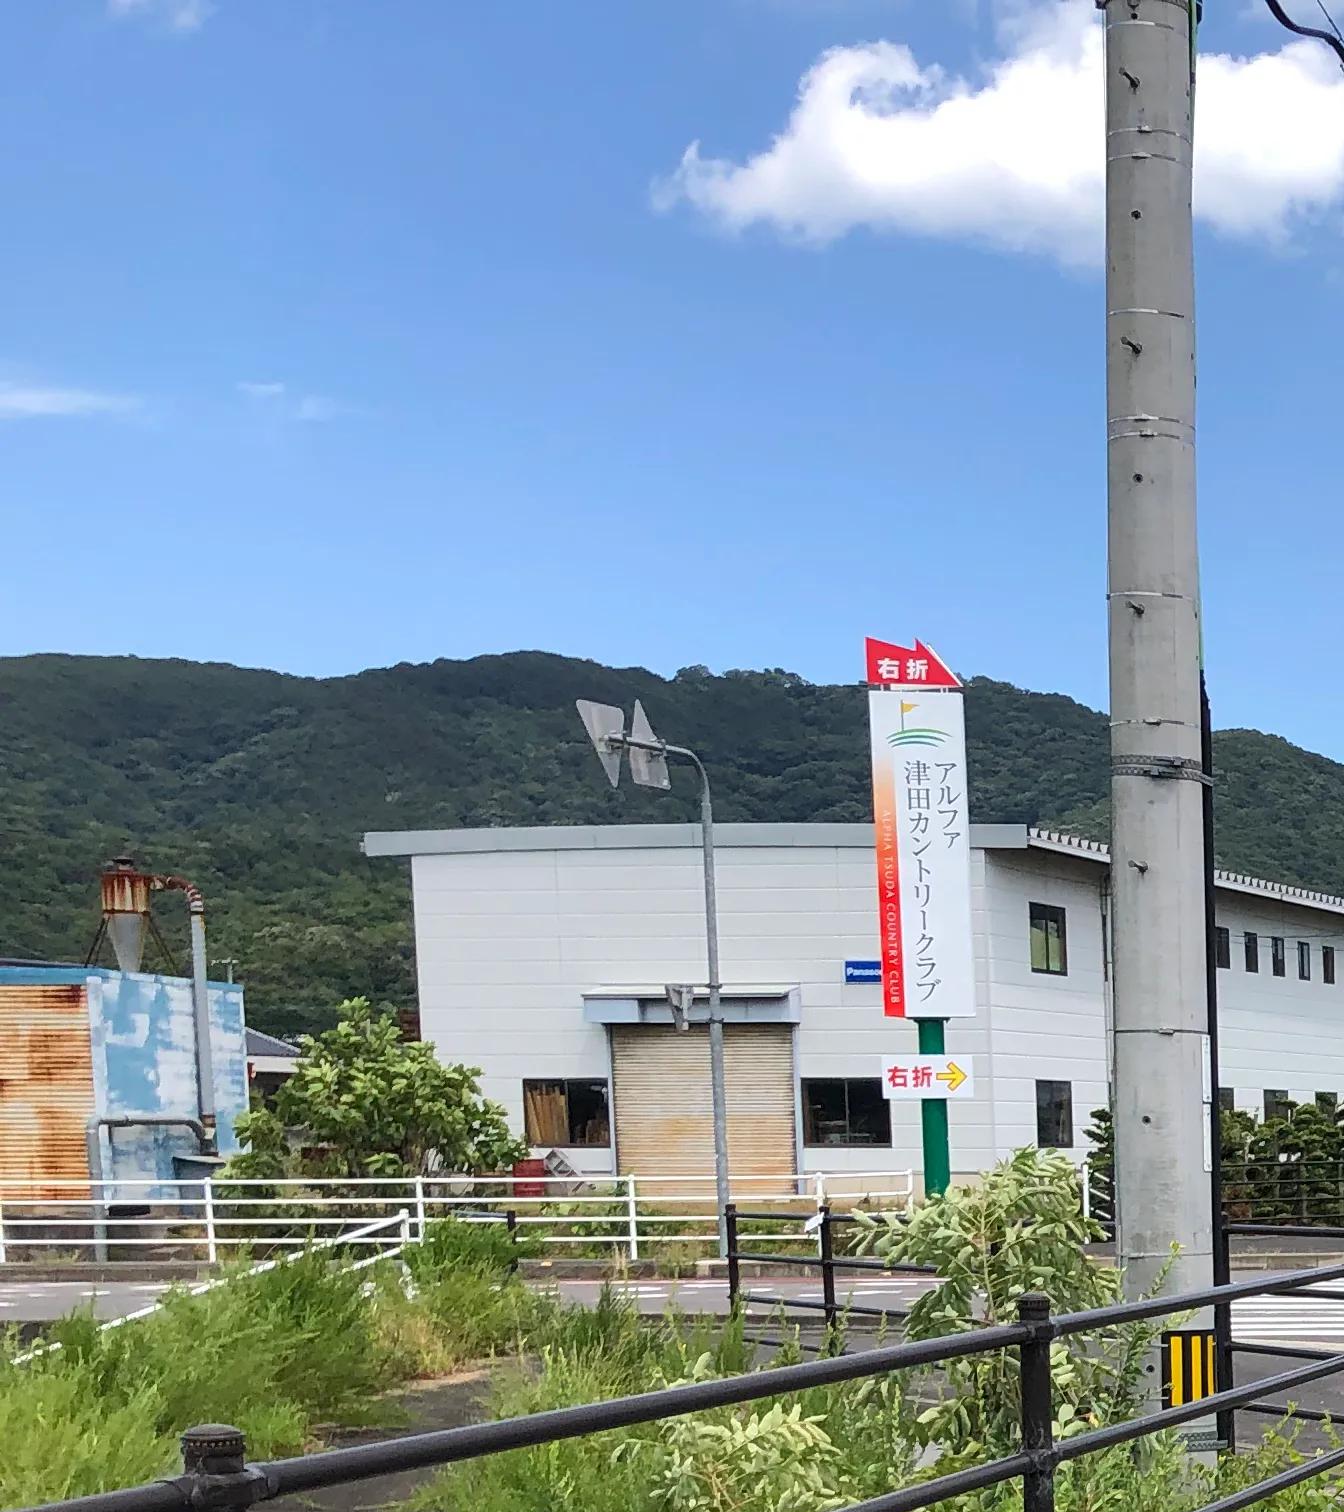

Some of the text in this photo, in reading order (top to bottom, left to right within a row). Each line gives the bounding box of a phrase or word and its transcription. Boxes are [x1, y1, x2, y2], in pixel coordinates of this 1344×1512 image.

[877, 658, 929, 681] 右折
[934, 761, 962, 849] アルファ
[882, 809, 901, 1004] ALPHA TSUDA COUNTRY CLUB
[903, 760, 942, 1002] 津田カントリークラブ
[887, 1066, 932, 1088] 右折
